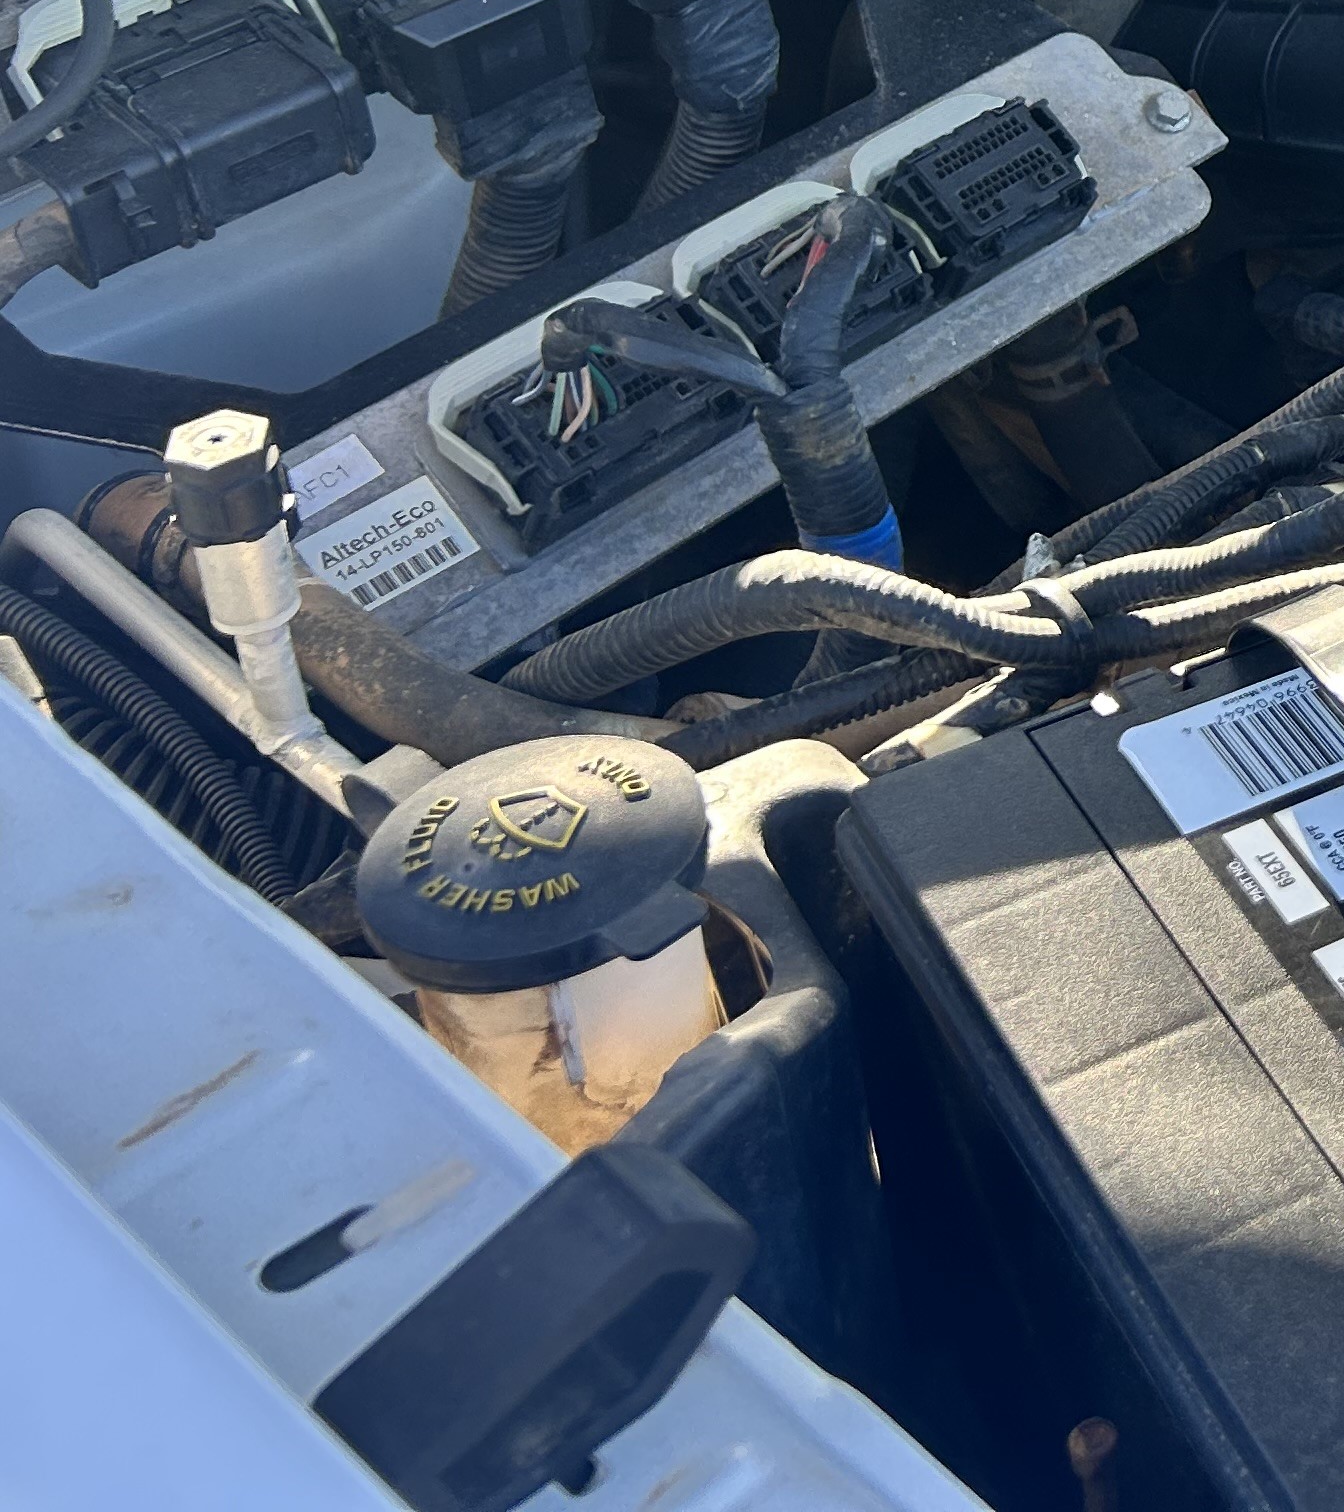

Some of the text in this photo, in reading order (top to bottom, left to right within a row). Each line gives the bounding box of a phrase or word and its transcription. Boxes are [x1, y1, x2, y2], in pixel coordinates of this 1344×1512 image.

[320, 500, 436, 569] Altech-Eco
[578, 756, 651, 801] ONLY
[402, 796, 580, 912] WASHER FLUID
[1254, 848, 1297, 889] 65EXT
[1223, 856, 1266, 902] PART NO.
